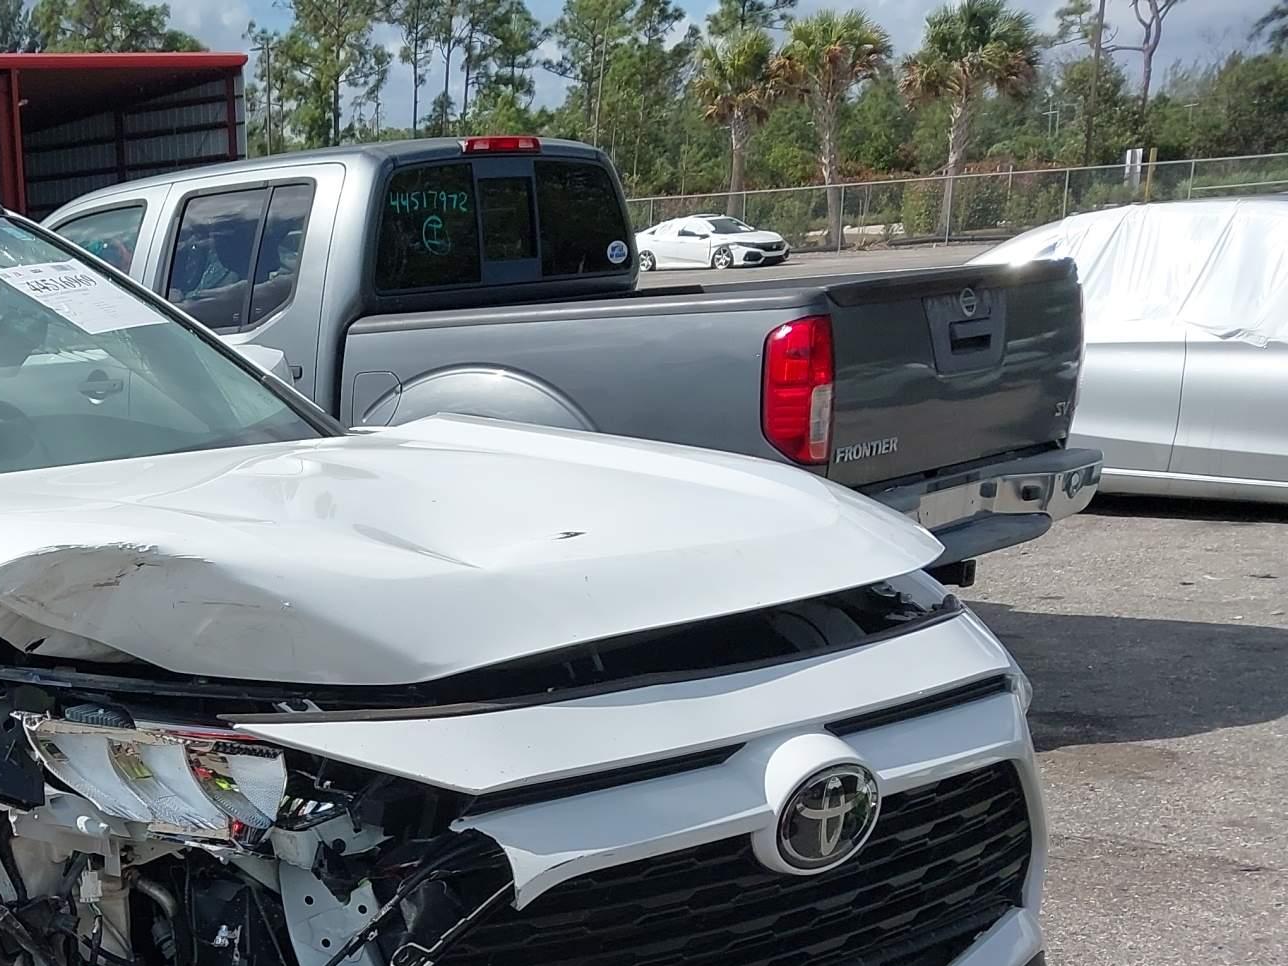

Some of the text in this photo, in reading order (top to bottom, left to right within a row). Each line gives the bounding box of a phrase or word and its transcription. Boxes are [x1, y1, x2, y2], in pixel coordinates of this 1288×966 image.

[389, 190, 468, 214] 44517972
[25, 274, 97, 293] 44516969
[835, 436, 899, 464] FRONTIER
